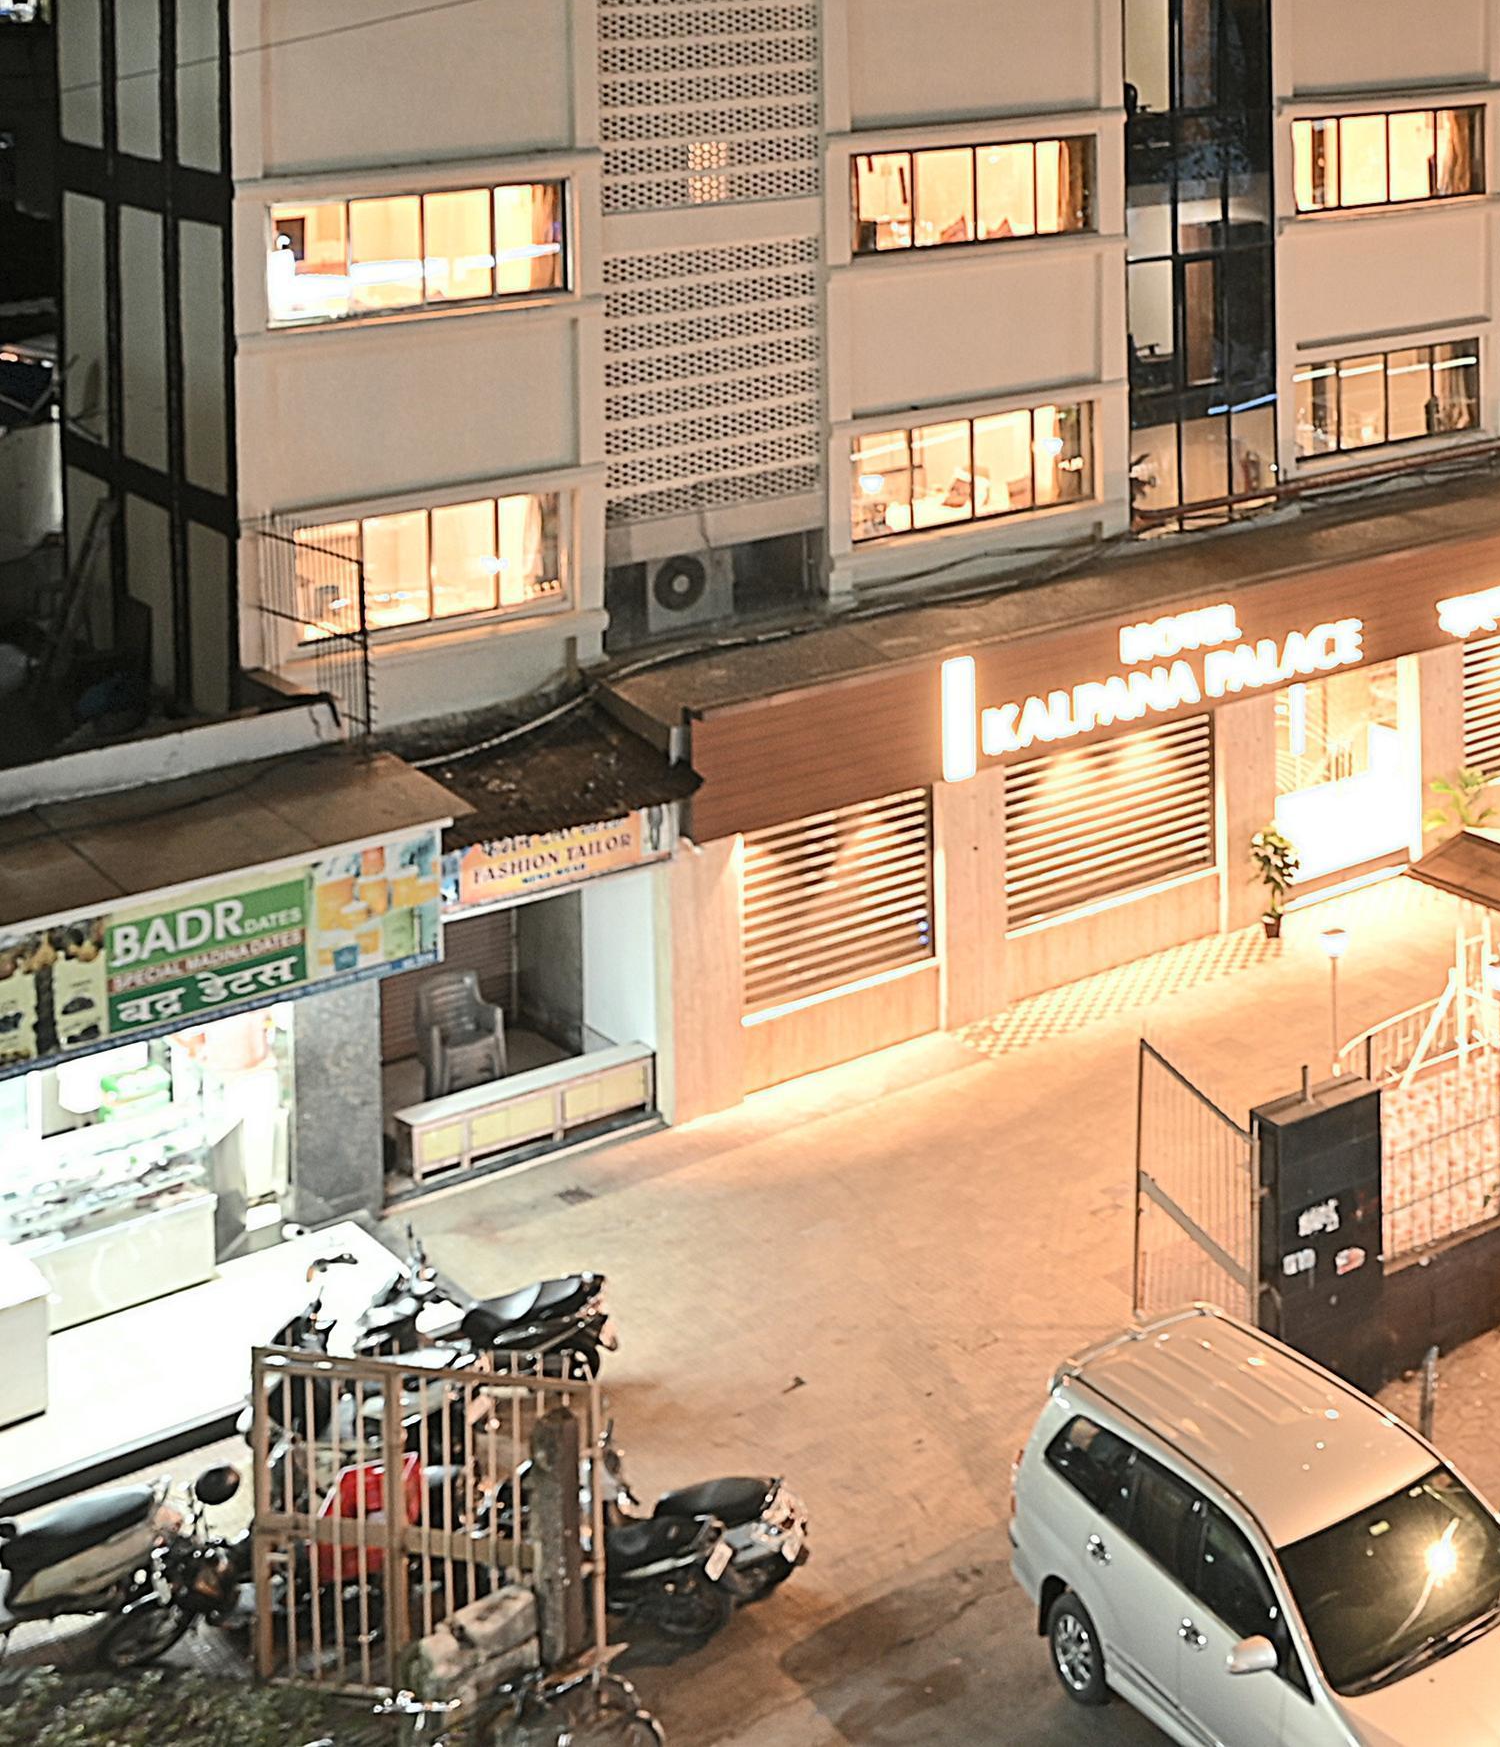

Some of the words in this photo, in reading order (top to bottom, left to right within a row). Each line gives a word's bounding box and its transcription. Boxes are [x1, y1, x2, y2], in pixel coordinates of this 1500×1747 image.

[981, 660, 1201, 756] KALPANA
[1204, 618, 1364, 698] PALACE
[473, 851, 560, 884] FASHION
[567, 832, 633, 865] TAILOR
[110, 899, 244, 968] BADR
[243, 906, 302, 936] DATES
[113, 962, 181, 992] SPECIAL
[186, 943, 249, 971] MADINA
[250, 929, 302, 955] DATES
